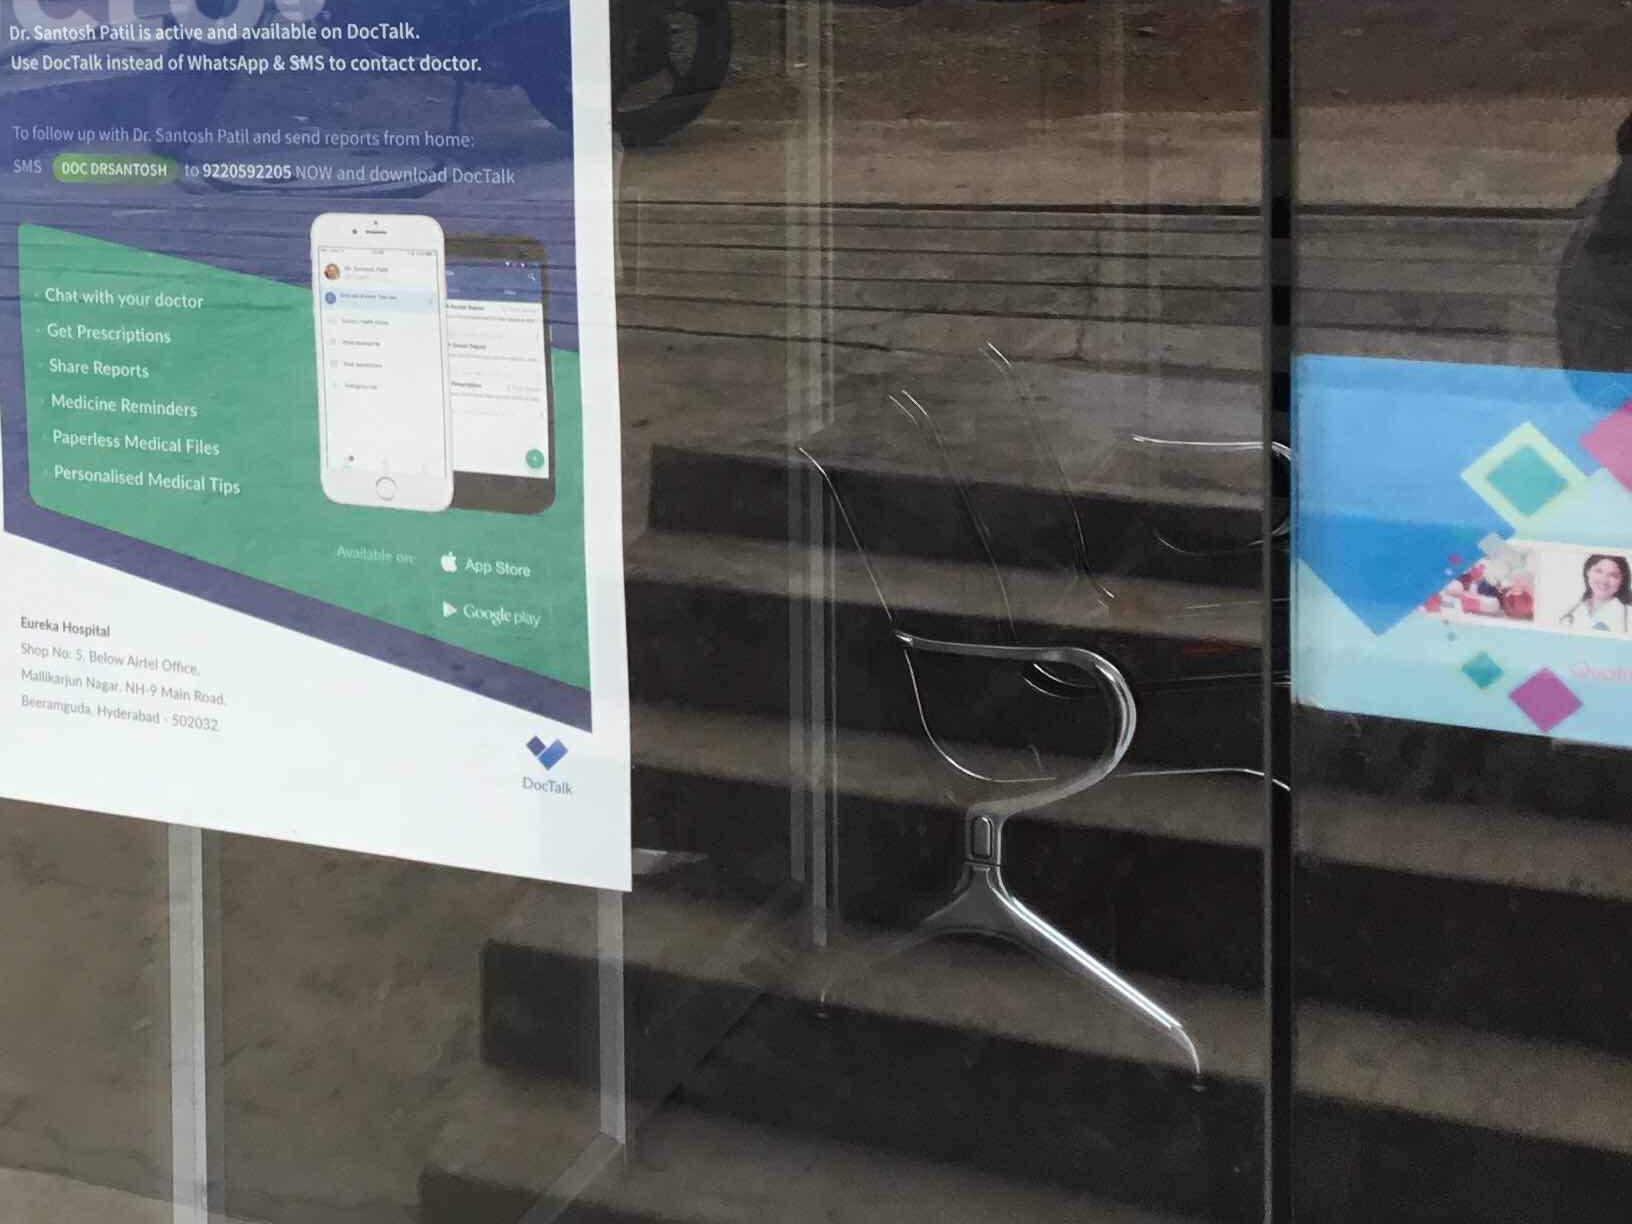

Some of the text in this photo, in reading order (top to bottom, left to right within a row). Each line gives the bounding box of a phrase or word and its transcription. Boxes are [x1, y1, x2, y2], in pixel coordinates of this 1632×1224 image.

[9, 22, 420, 42] Dr. Santosh Patil is active and available on DocTalk.
[11, 54, 482, 75] Use DocTalk instead of WhatsApp & SMS to contact doctor.
[13, 126, 29, 140] To
[32, 126, 74, 142] follow
[77, 130, 96, 145] up
[98, 127, 129, 142] with
[133, 127, 152, 143] Dr.
[155, 127, 214, 143] Santosh
[217, 128, 249, 144] Patil
[253, 128, 281, 144] and
[285, 128, 319, 145] send
[325, 130, 380, 149] reports
[384, 130, 420, 147] from
[13, 159, 516, 184] SMS DOC DRSANTOSH to 9220592205 NOW and download DocTalk
[44, 287, 205, 309] Chat with your doctor
[47, 322, 172, 344] Get Prescriptions
[49, 357, 150, 379] Share Reports
[51, 393, 198, 418] Medicine Reminders
[52, 429, 220, 457] Paperless Medical Files
[54, 464, 241, 497] Personalised Medical Tips
[336, 544, 394, 563] Available
[464, 558, 531, 578] App Store
[463, 603, 541, 628] Google play
[20, 616, 111, 638] Eureka Hospital
[20, 642, 49, 658] Shop
[89, 650, 123, 667] Below
[127, 655, 159, 671] Airtel
[21, 668, 83, 689] Mallikarjun
[125, 681, 158, 697] NH-9
[160, 686, 191, 702] Main
[96, 704, 160, 725] Hyderabad
[522, 775, 574, 795] DocTalk
